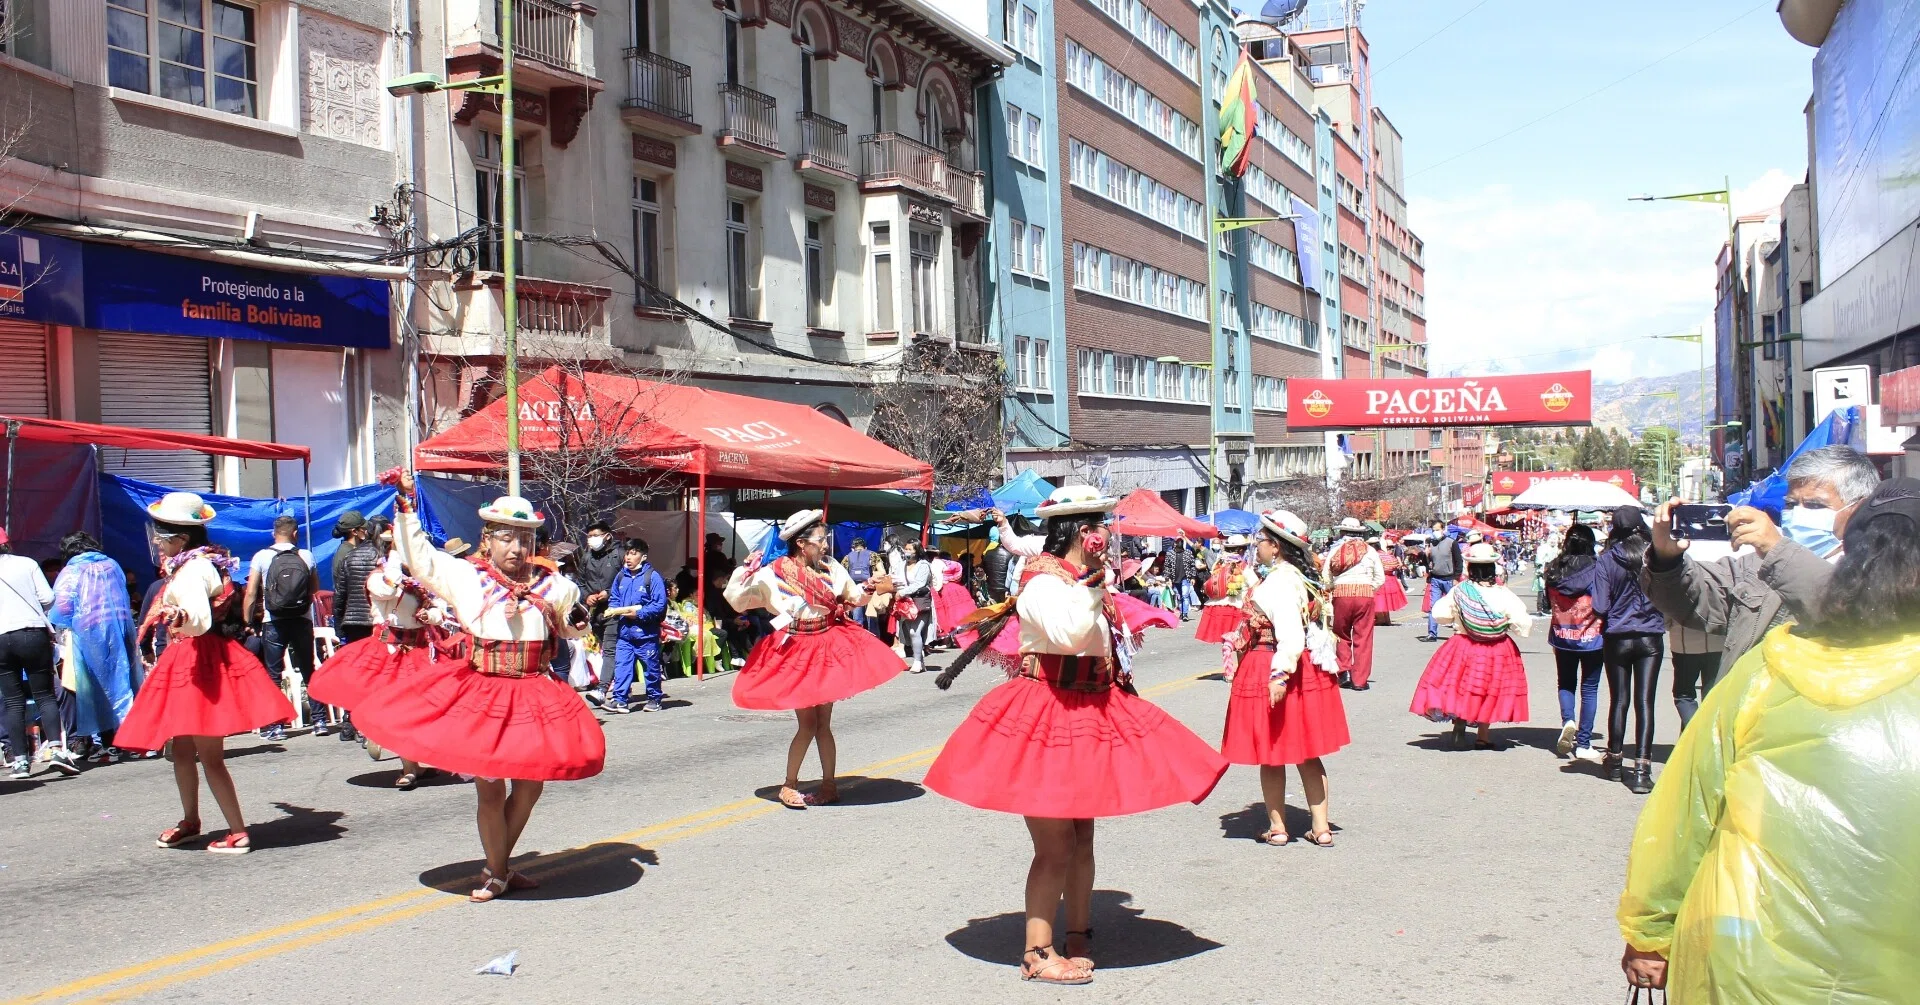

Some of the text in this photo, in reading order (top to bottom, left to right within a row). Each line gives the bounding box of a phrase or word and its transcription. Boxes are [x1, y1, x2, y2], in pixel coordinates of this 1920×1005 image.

[202, 276, 305, 302] Protegiendo a la
[181, 298, 322, 329] familia Boliviana
[506, 396, 594, 421] ACEÑA
[1365, 381, 1508, 415] PACEÑA
[1433, 415, 1490, 423] BOLIVIANA
[718, 450, 750, 466] PACEÑA
